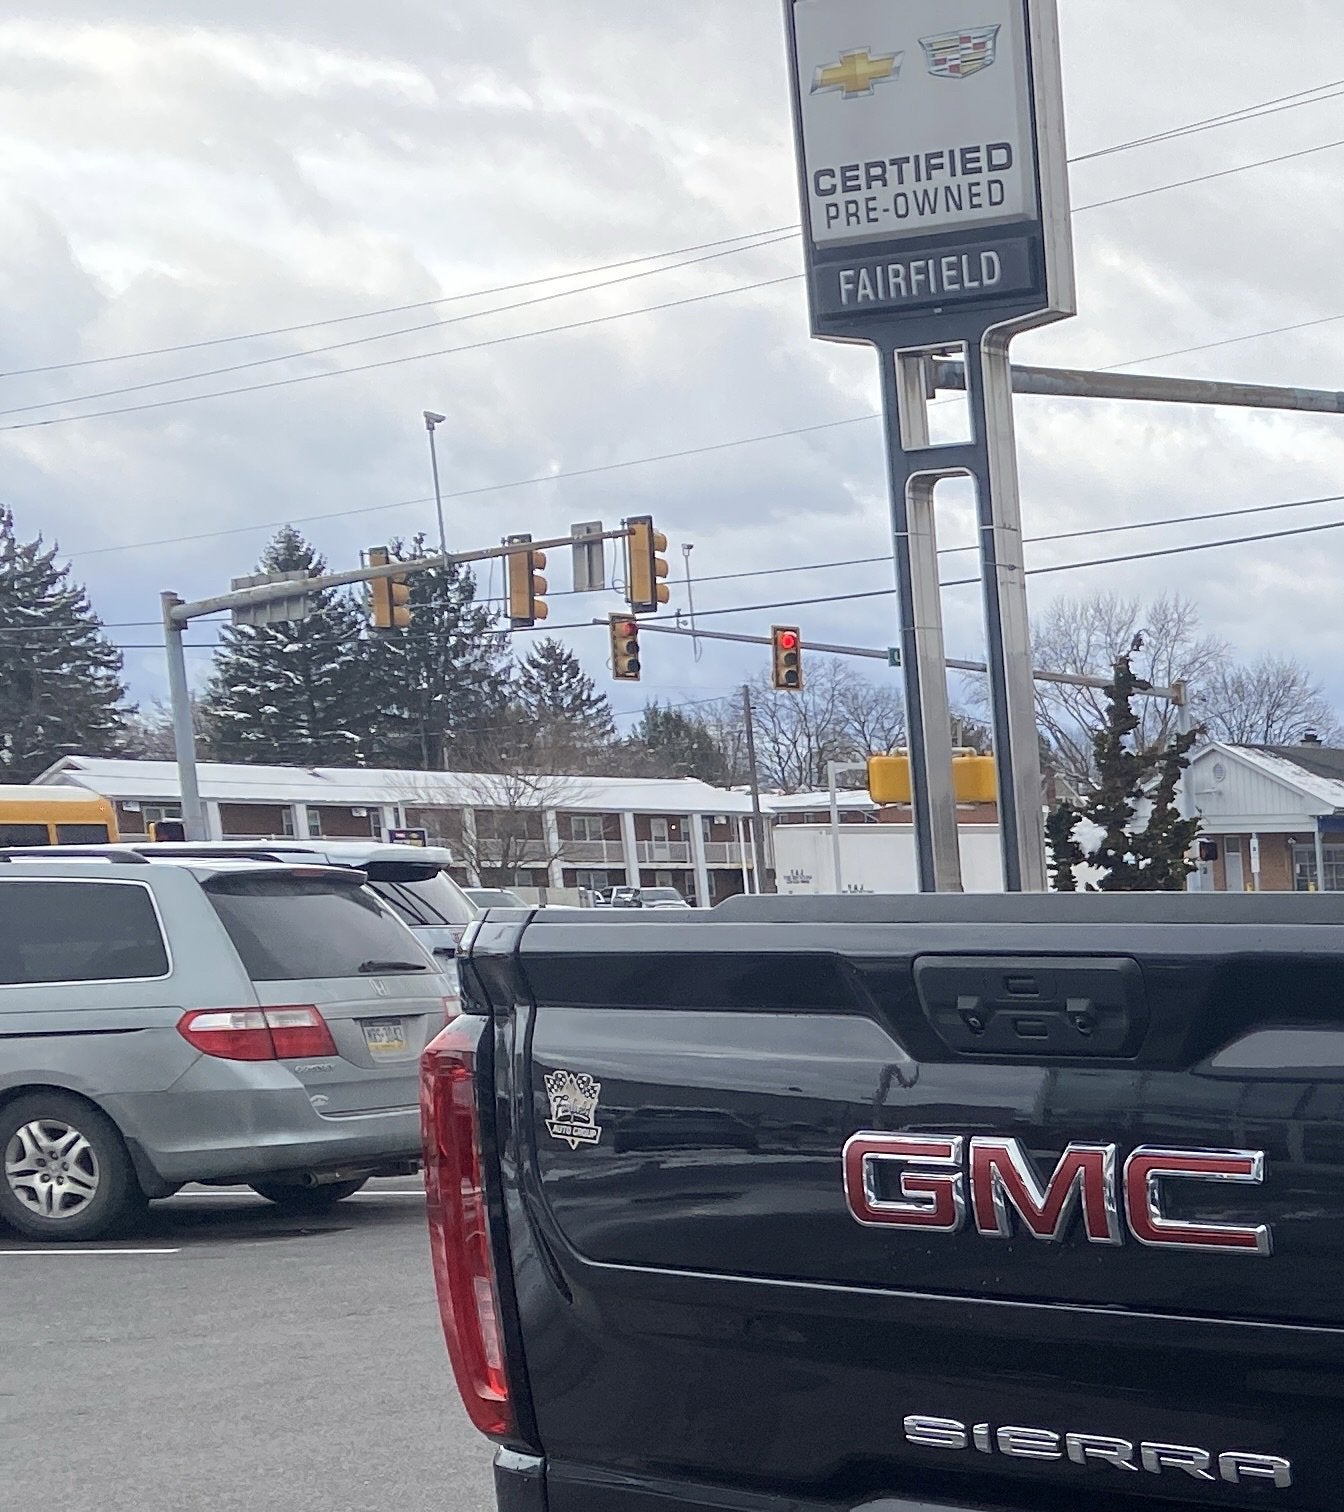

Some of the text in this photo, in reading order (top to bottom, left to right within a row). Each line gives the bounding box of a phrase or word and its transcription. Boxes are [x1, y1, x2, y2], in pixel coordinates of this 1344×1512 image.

[813, 142, 1012, 197] CERTIFIED
[826, 179, 1004, 229] PRE-OWNED
[839, 250, 1001, 305] FAIRFIELD
[552, 1124, 597, 1139] AUTO GROUP
[842, 1130, 1273, 1257] GMC
[903, 1415, 1293, 1488] SIERRA
